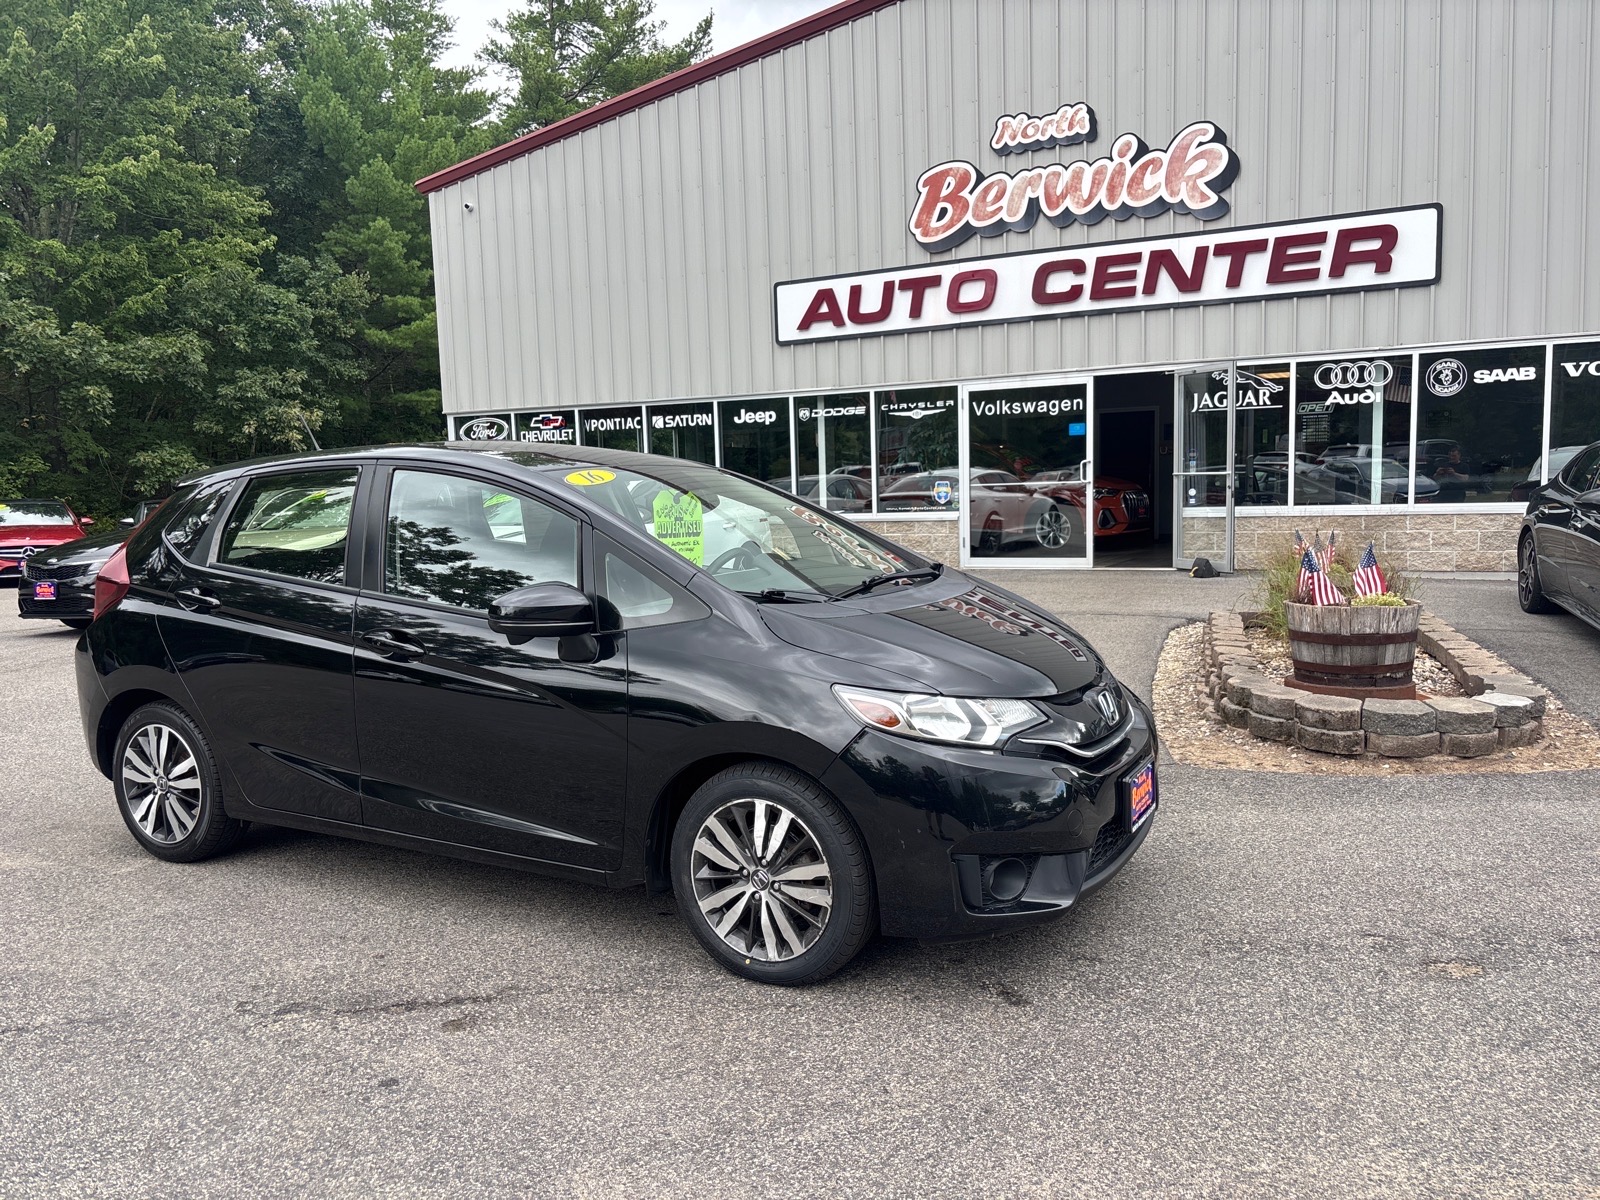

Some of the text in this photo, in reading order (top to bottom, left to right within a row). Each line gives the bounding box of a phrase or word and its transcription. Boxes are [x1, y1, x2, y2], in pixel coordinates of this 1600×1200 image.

[993, 103, 1093, 151] North
[910, 121, 1230, 246] Berwick
[796, 223, 1400, 331] AUTO CENTER
[1435, 361, 1458, 371] SAAB
[1473, 366, 1537, 384] SAAB
[1191, 390, 1272, 412] JAGUAR
[1324, 389, 1381, 405] Audi
[811, 406, 866, 418] DODGE
[881, 400, 954, 411] CHRYSLER
[972, 398, 1084, 416] Volkswagen
[1298, 403, 1333, 413] OPEN
[590, 416, 642, 432] PONTIAC
[664, 413, 712, 428] SATURN
[733, 408, 777, 426] Jeep
[470, 422, 498, 439] Ford
[520, 429, 574, 443] CHEVROLET
[578, 470, 605, 485] 16
[656, 520, 702, 537] ADVERTISED
